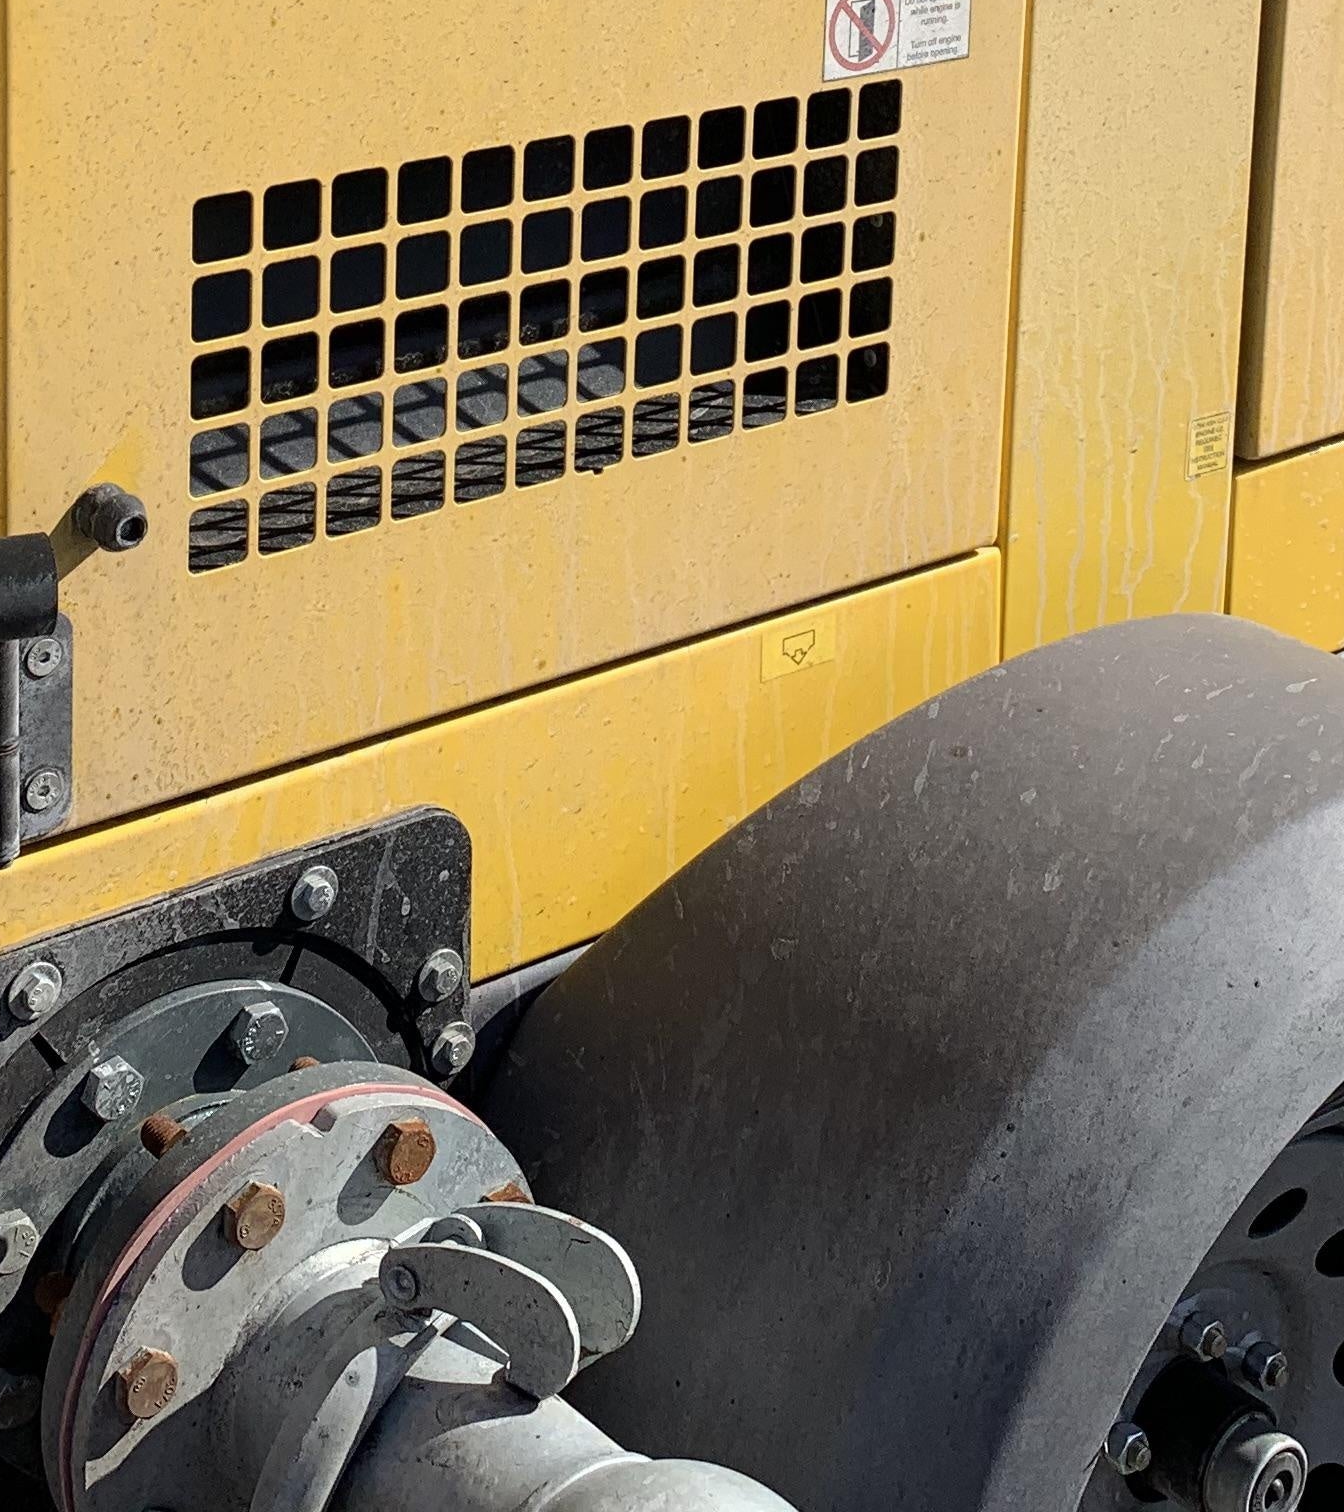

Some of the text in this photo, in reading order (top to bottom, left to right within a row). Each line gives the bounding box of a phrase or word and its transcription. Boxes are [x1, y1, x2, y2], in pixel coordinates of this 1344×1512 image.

[911, 5, 928, 16] while
[930, 3, 953, 13] engine
[911, 34, 961, 49] Turn off engine
[907, 50, 928, 61] before
